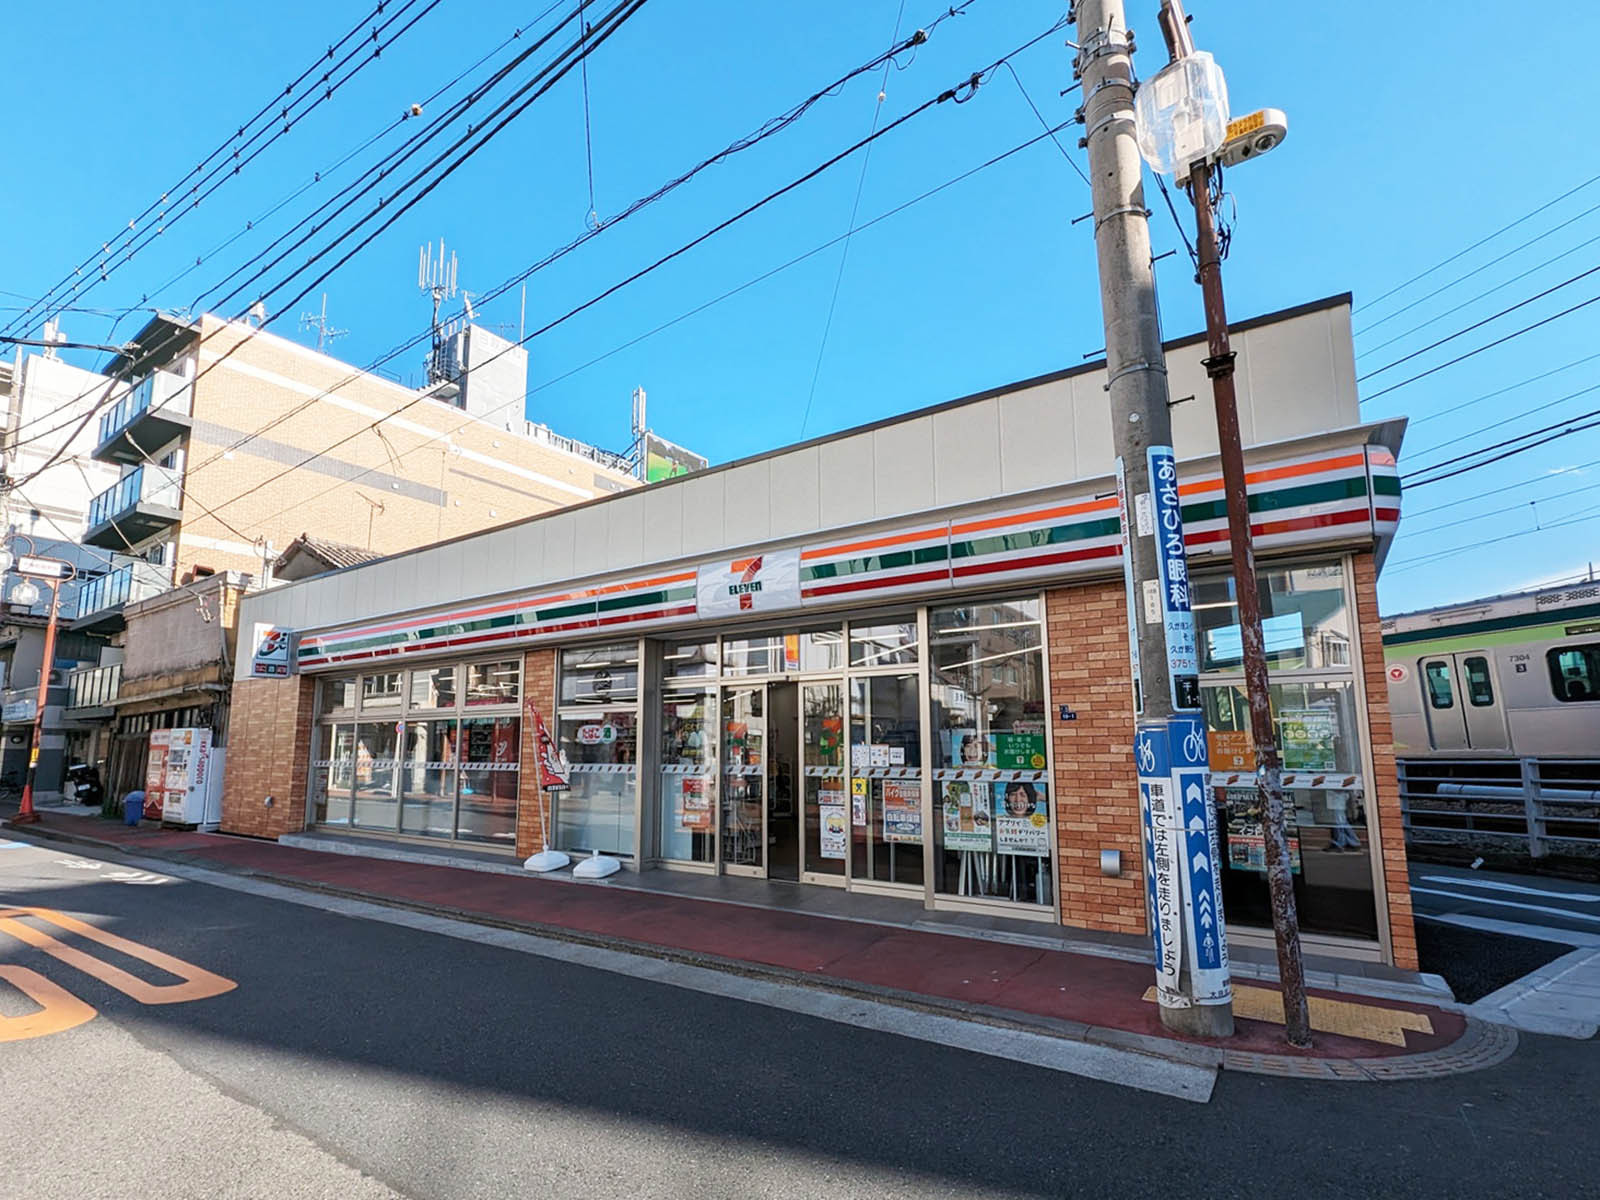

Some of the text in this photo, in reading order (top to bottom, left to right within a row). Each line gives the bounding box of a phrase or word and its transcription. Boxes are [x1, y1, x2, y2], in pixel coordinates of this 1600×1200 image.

[1157, 458, 1189, 608] あさひろ眼科
[1507, 654, 1530, 662] 7304
[1150, 783, 1176, 976] 車道では左側を走りましょう
